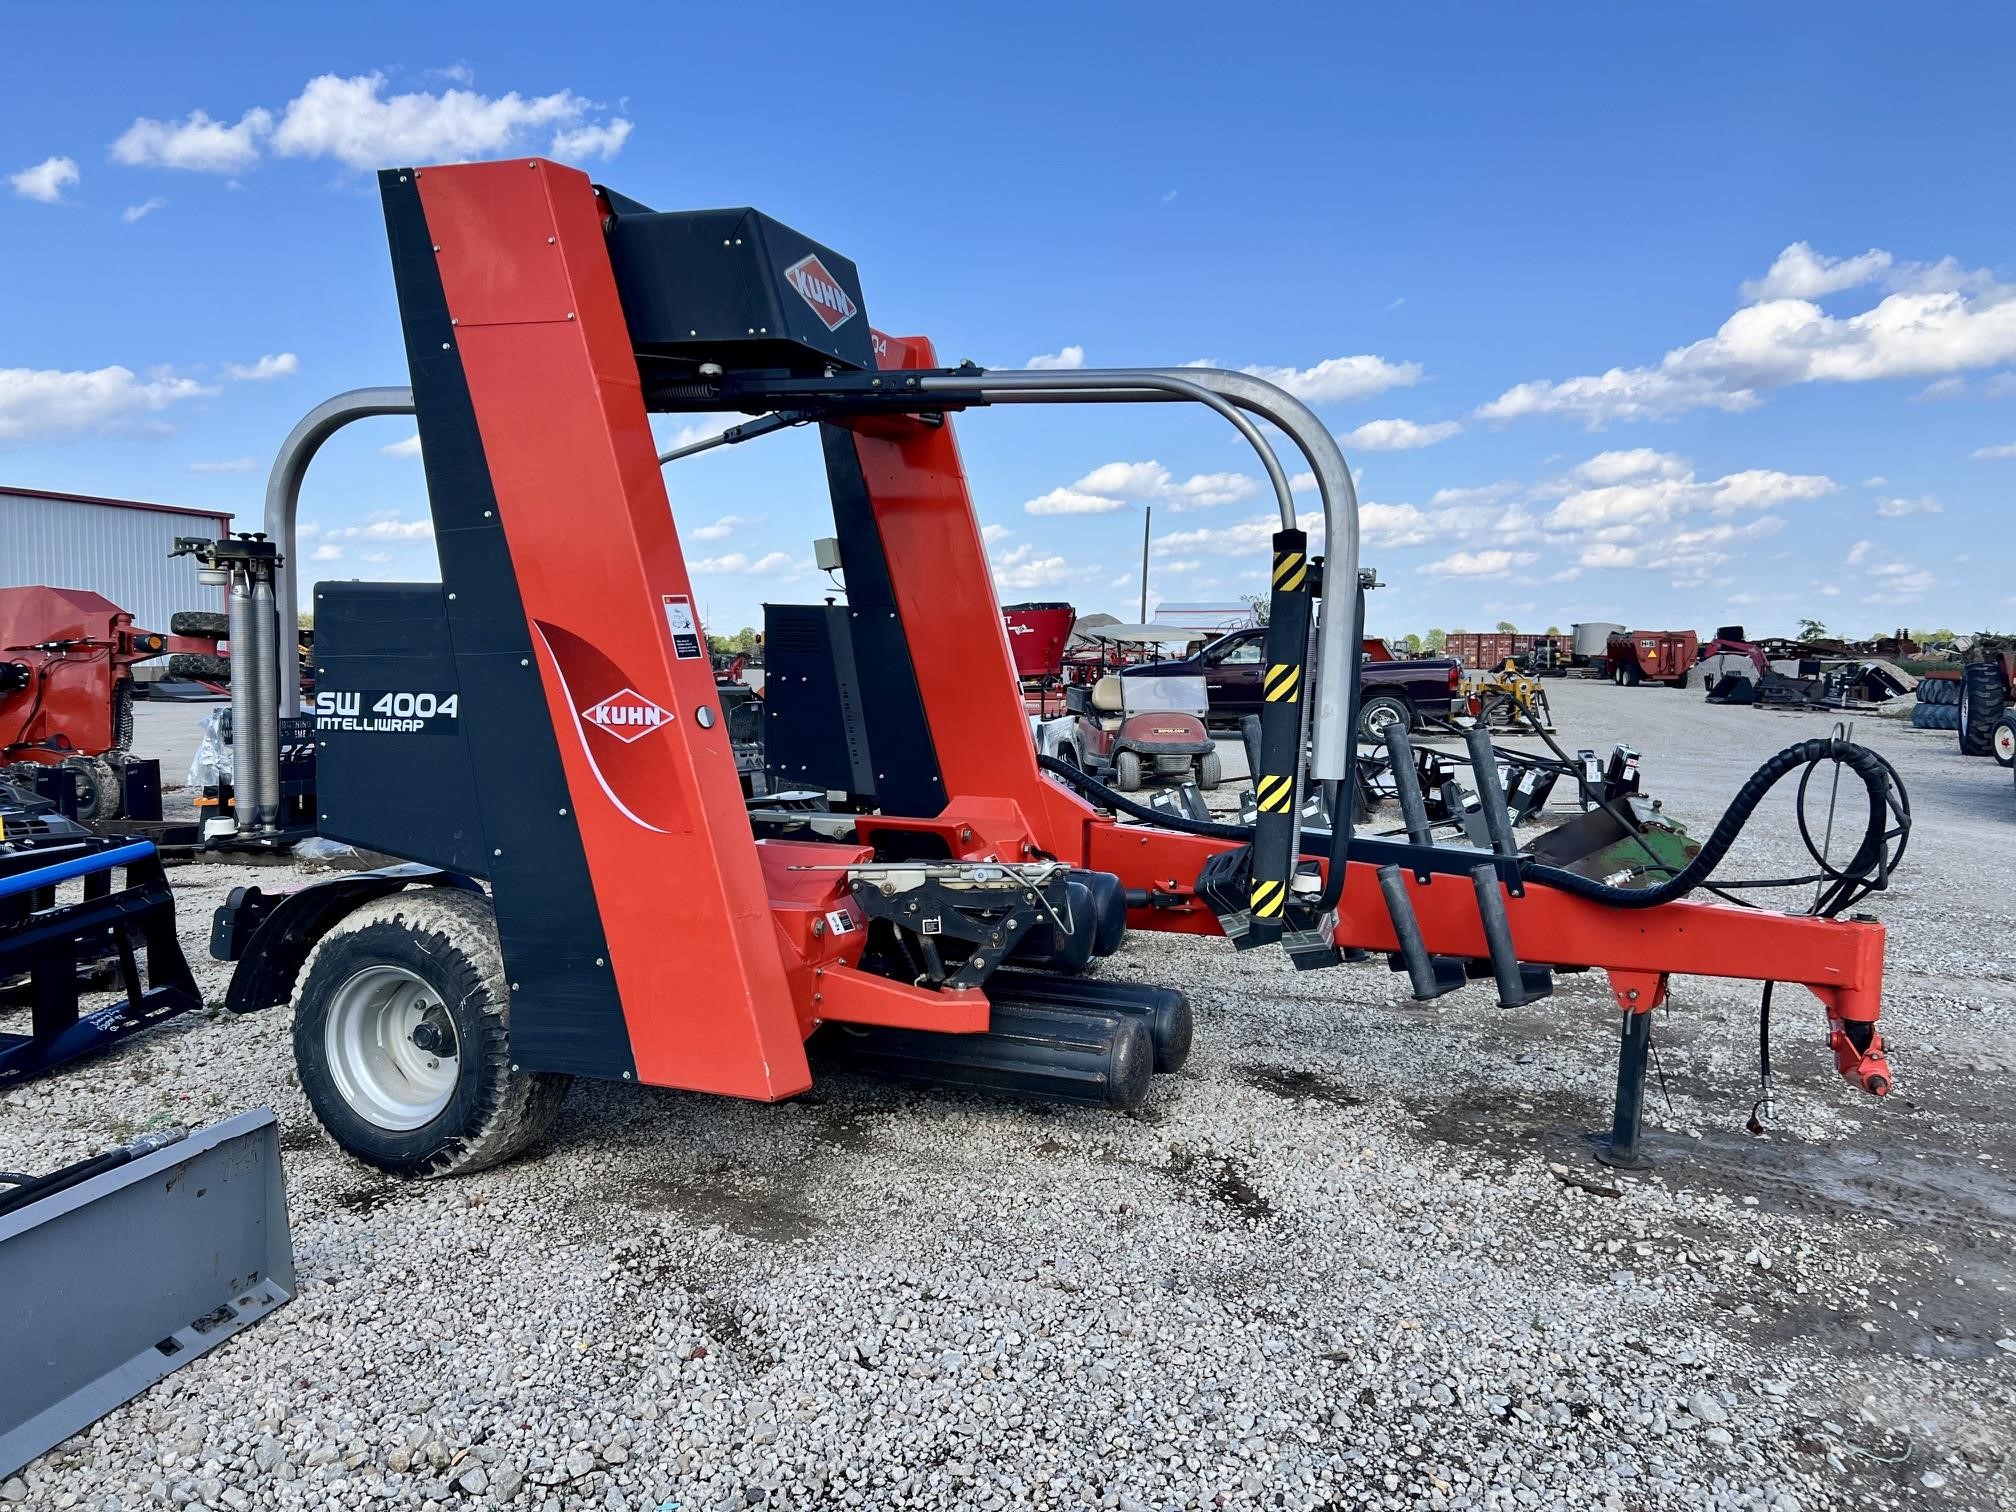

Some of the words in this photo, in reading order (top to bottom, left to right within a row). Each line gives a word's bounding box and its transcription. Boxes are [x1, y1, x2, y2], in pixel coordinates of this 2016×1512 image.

[794, 267, 849, 317] KUHN
[316, 692, 361, 716] SW
[372, 692, 458, 718] 4004
[596, 705, 661, 727] KUHN
[316, 717, 425, 732] INTELLIWRAP
